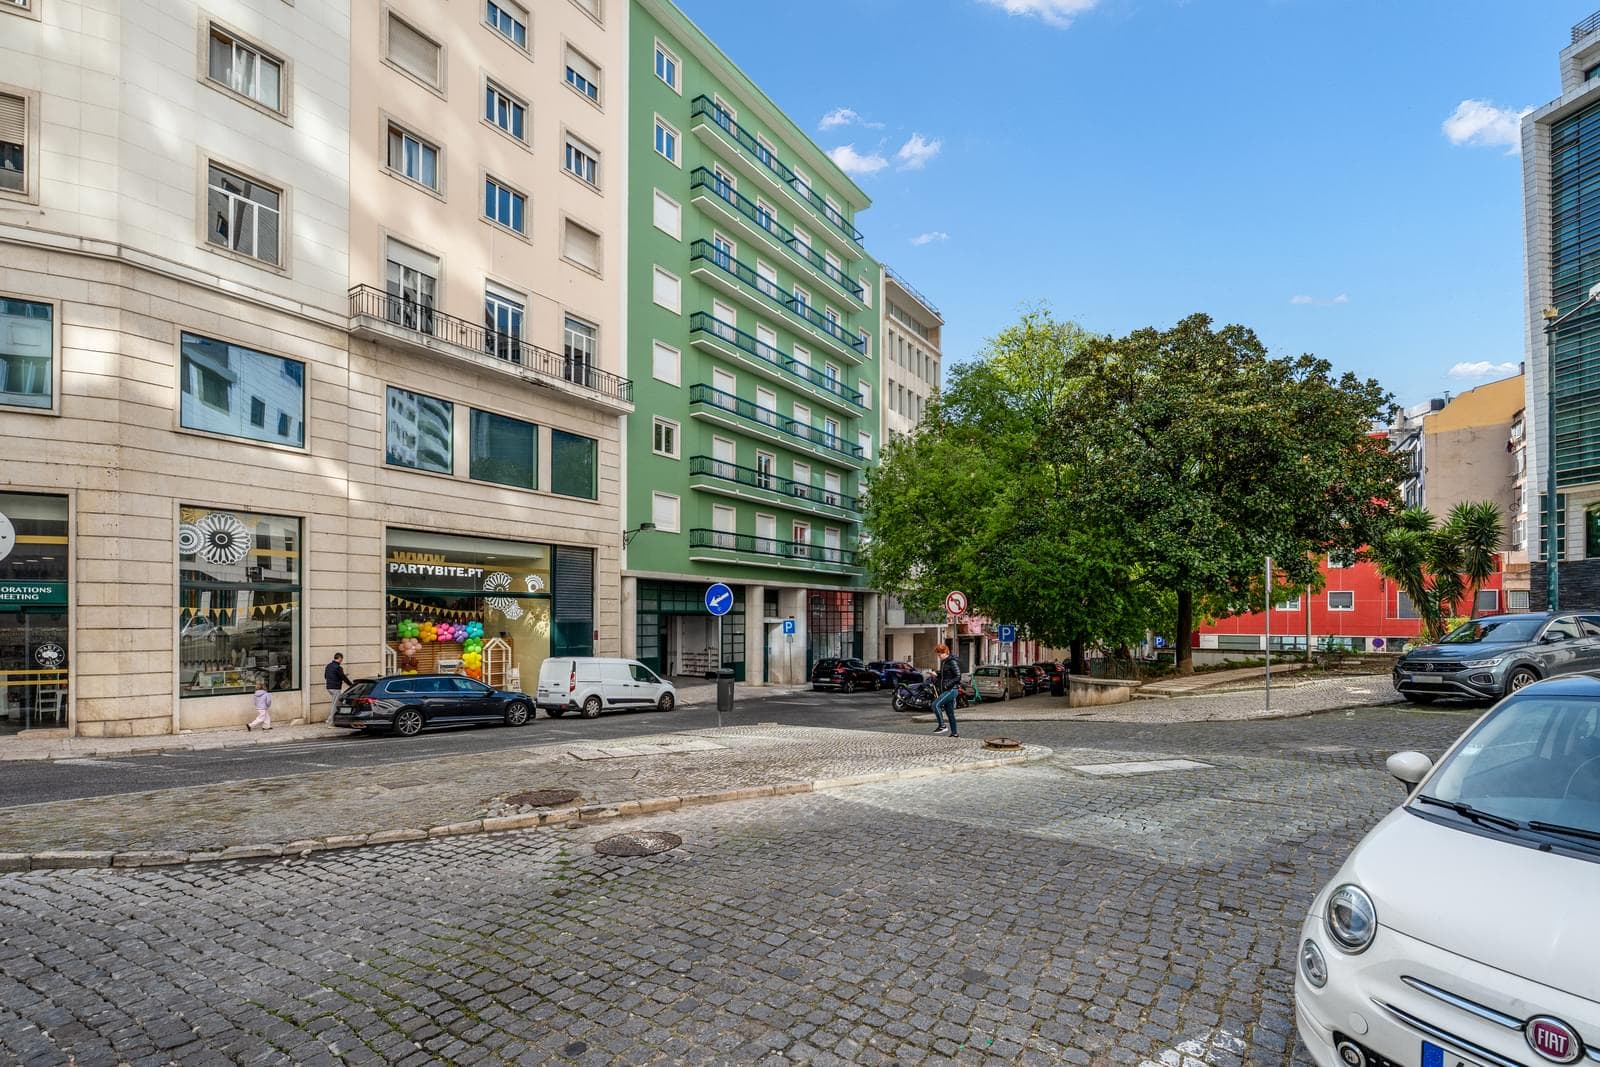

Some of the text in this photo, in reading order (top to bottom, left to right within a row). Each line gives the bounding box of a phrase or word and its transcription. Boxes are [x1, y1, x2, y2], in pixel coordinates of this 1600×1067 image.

[389, 562, 484, 578] PARTYBITE.PT
[785, 621, 793, 632] P
[1002, 627, 1011, 640] P
[1537, 1027, 1567, 1053] FIAT
